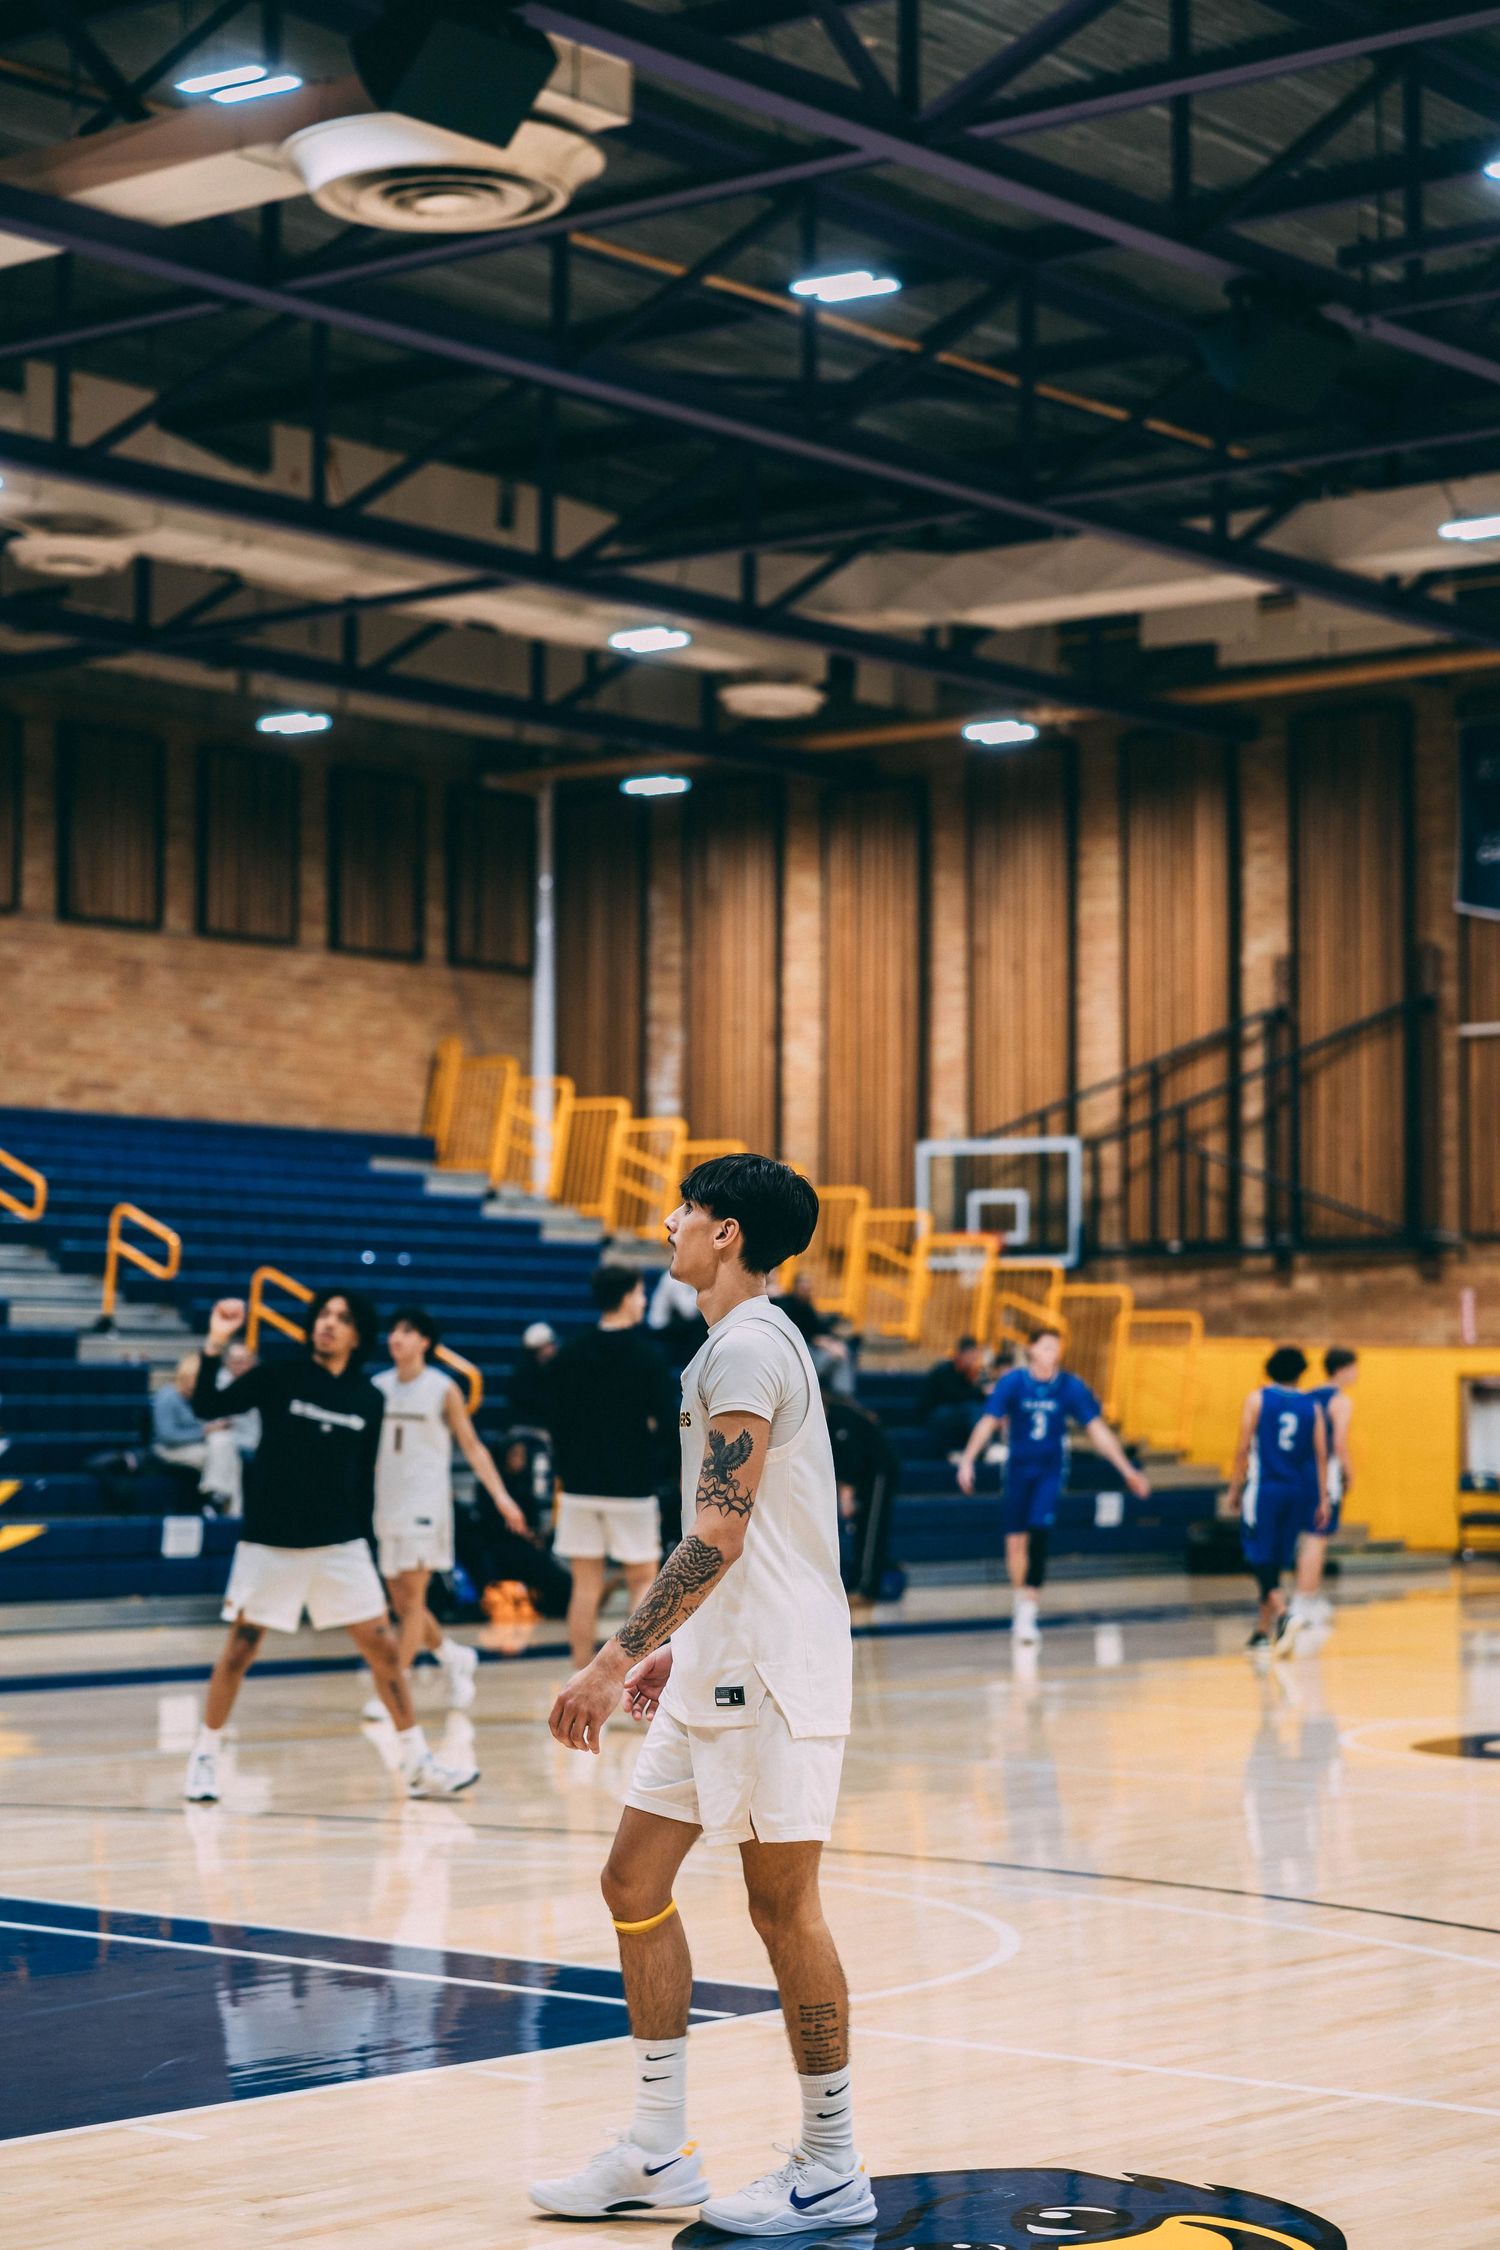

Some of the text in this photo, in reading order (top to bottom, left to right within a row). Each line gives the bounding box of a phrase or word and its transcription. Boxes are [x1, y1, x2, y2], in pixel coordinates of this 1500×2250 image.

[1031, 1410, 1047, 1440] 3
[1279, 1412, 1297, 1451] 2
[733, 1692, 738, 1700] L
